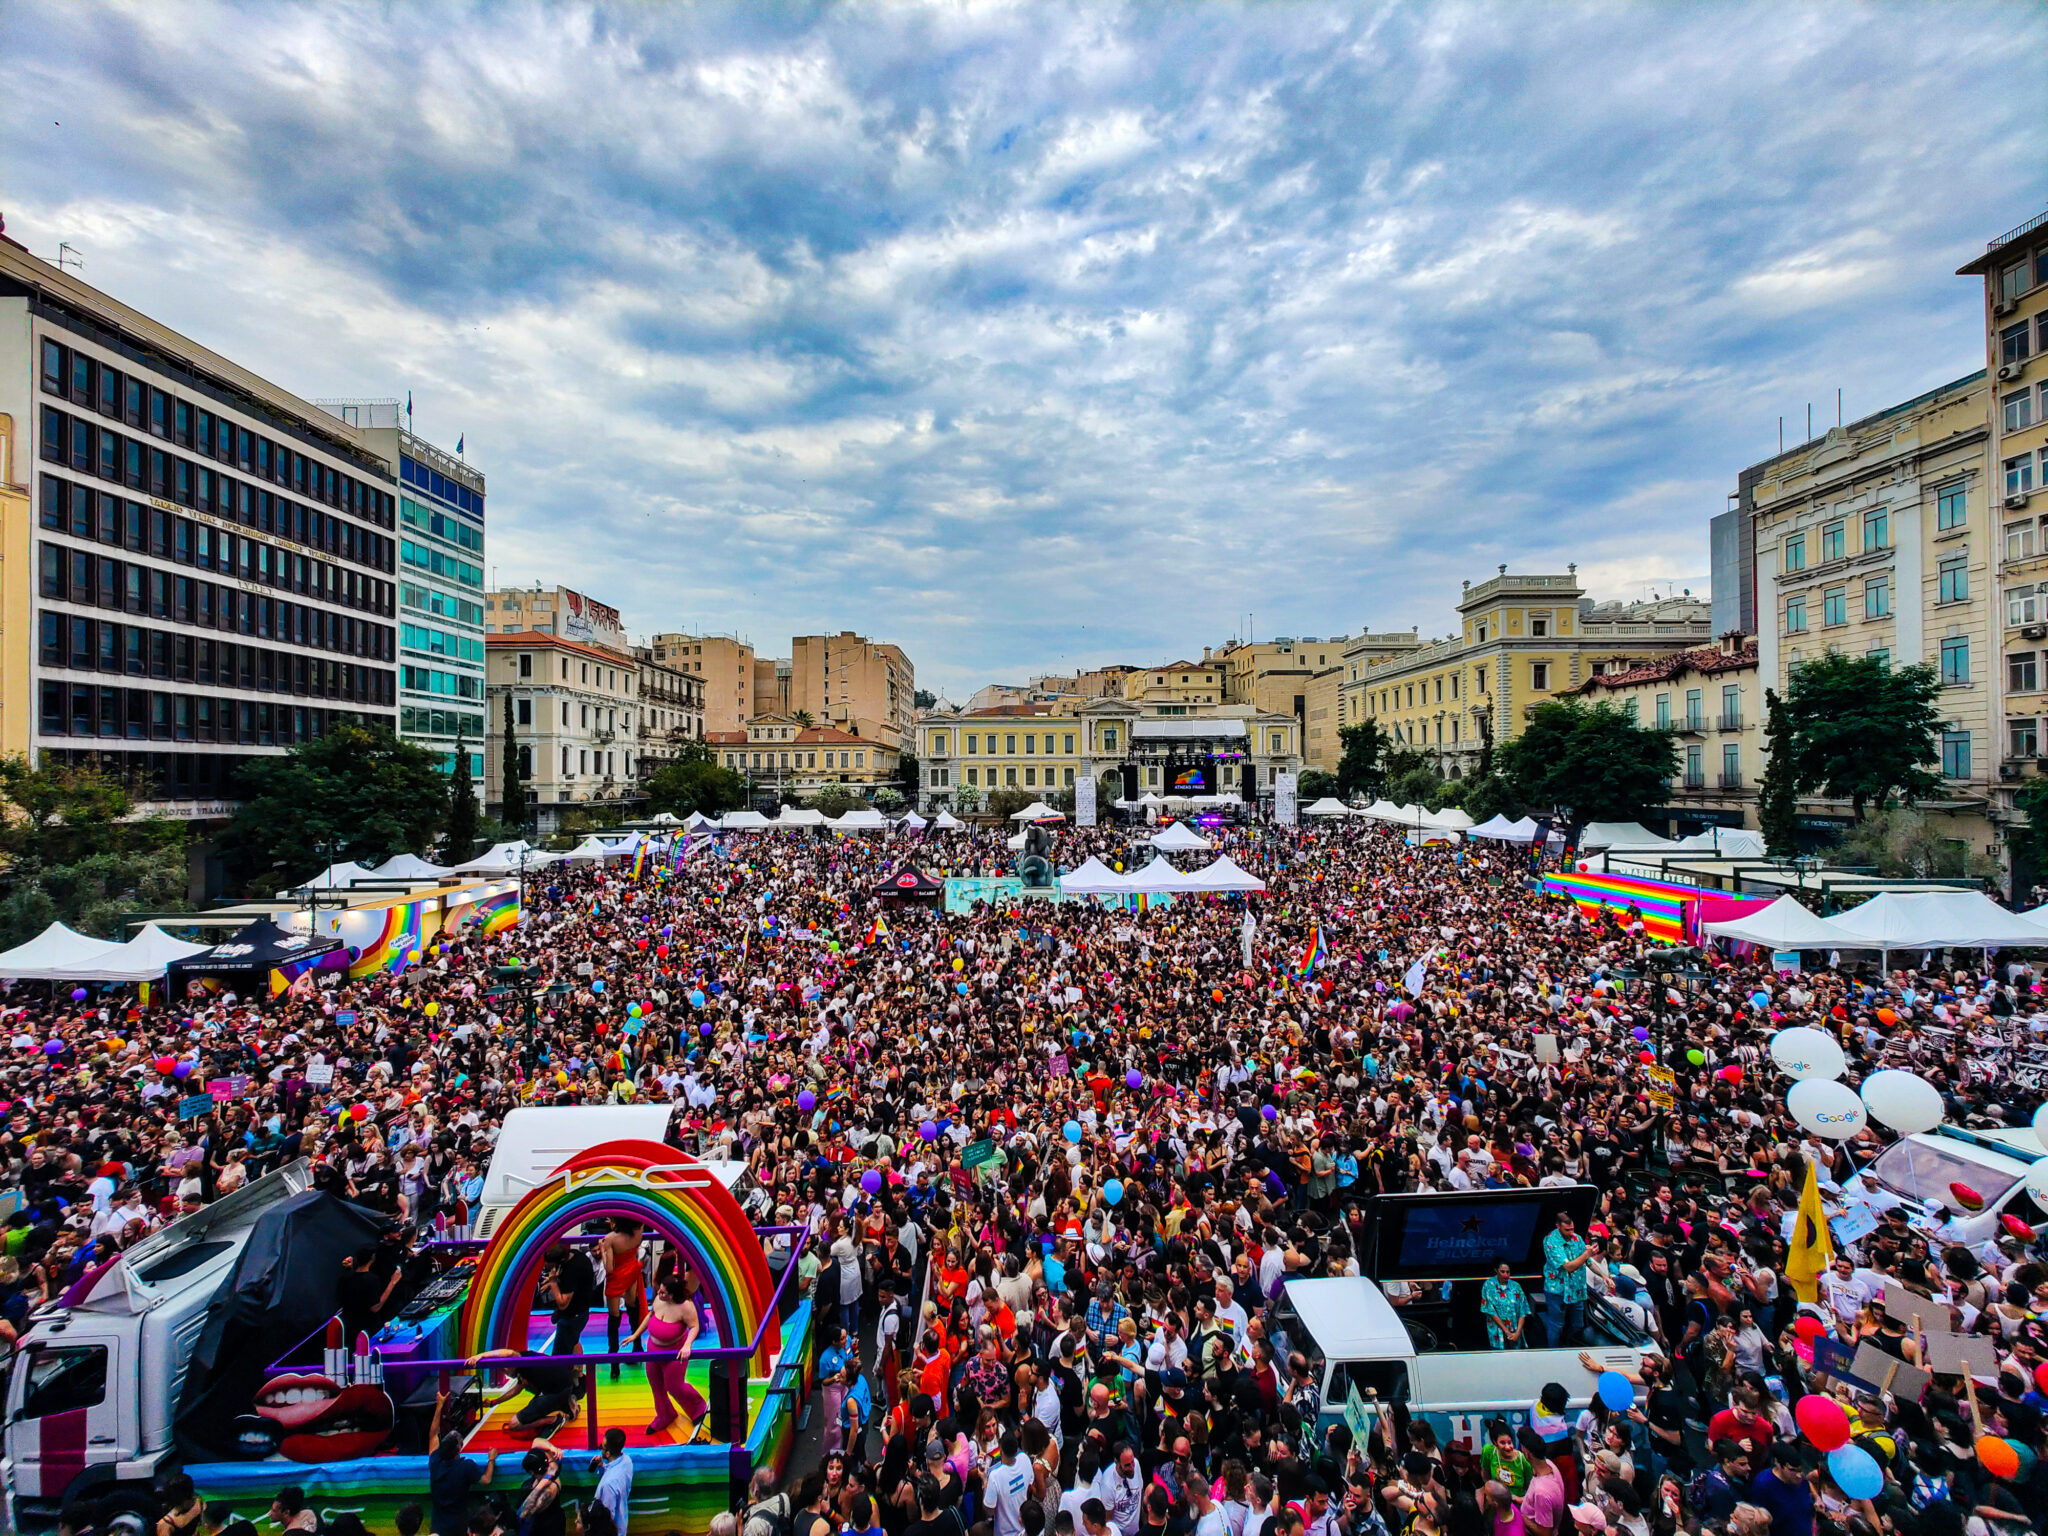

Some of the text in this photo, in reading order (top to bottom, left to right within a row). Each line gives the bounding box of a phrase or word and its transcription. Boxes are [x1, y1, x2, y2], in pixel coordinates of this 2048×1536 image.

[1620, 867, 1697, 886] ONASSIS STEGI
[1816, 1109, 1859, 1123] Google
[1427, 1235, 1507, 1248] Heineken
[1435, 1249, 1494, 1259] SILVER
